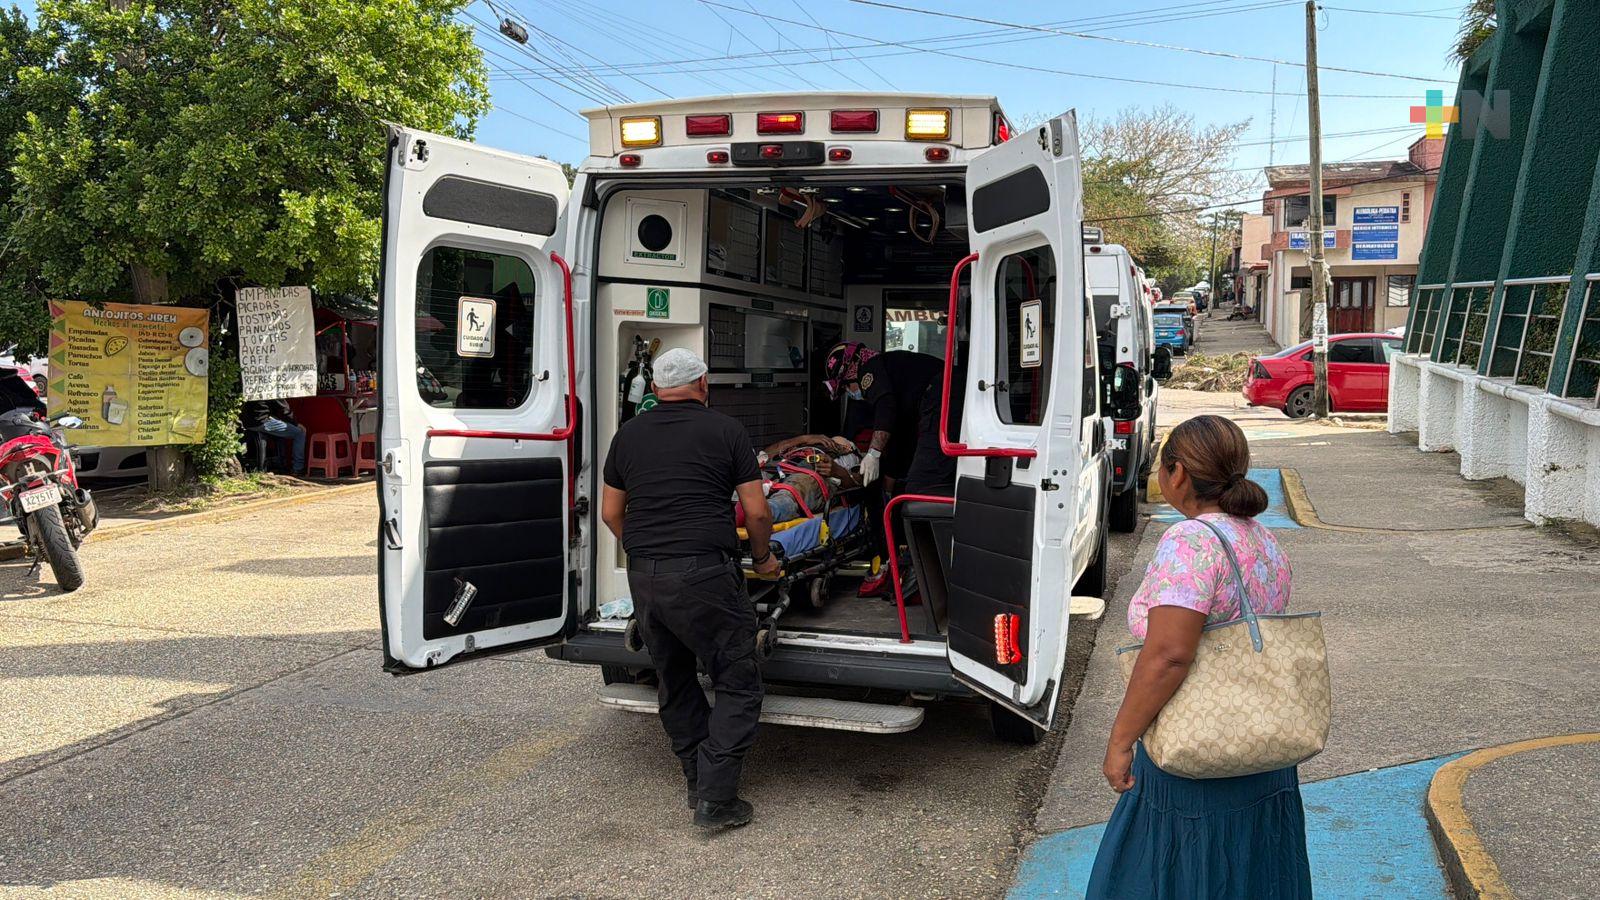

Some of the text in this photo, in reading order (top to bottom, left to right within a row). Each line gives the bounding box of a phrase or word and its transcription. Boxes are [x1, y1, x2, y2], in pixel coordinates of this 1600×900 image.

[239, 287, 300, 301] EMPANADAS
[238, 300, 280, 314] PICADAS
[84, 308, 177, 323] ANTOJITOS JIREH
[239, 309, 288, 325] TOSTADAS
[68, 328, 109, 336] Empanadas
[239, 321, 291, 335] PANUCHOS
[240, 332, 288, 347] TORTAS
[68, 343, 99, 351] Tostadas
[241, 344, 277, 355] AVENA
[68, 351, 103, 360] Panuchos
[244, 373, 287, 385] REFRESOS
[68, 389, 99, 397] Refresco
[68, 398, 90, 406] Aguas
[67, 406, 89, 414] Jugos
